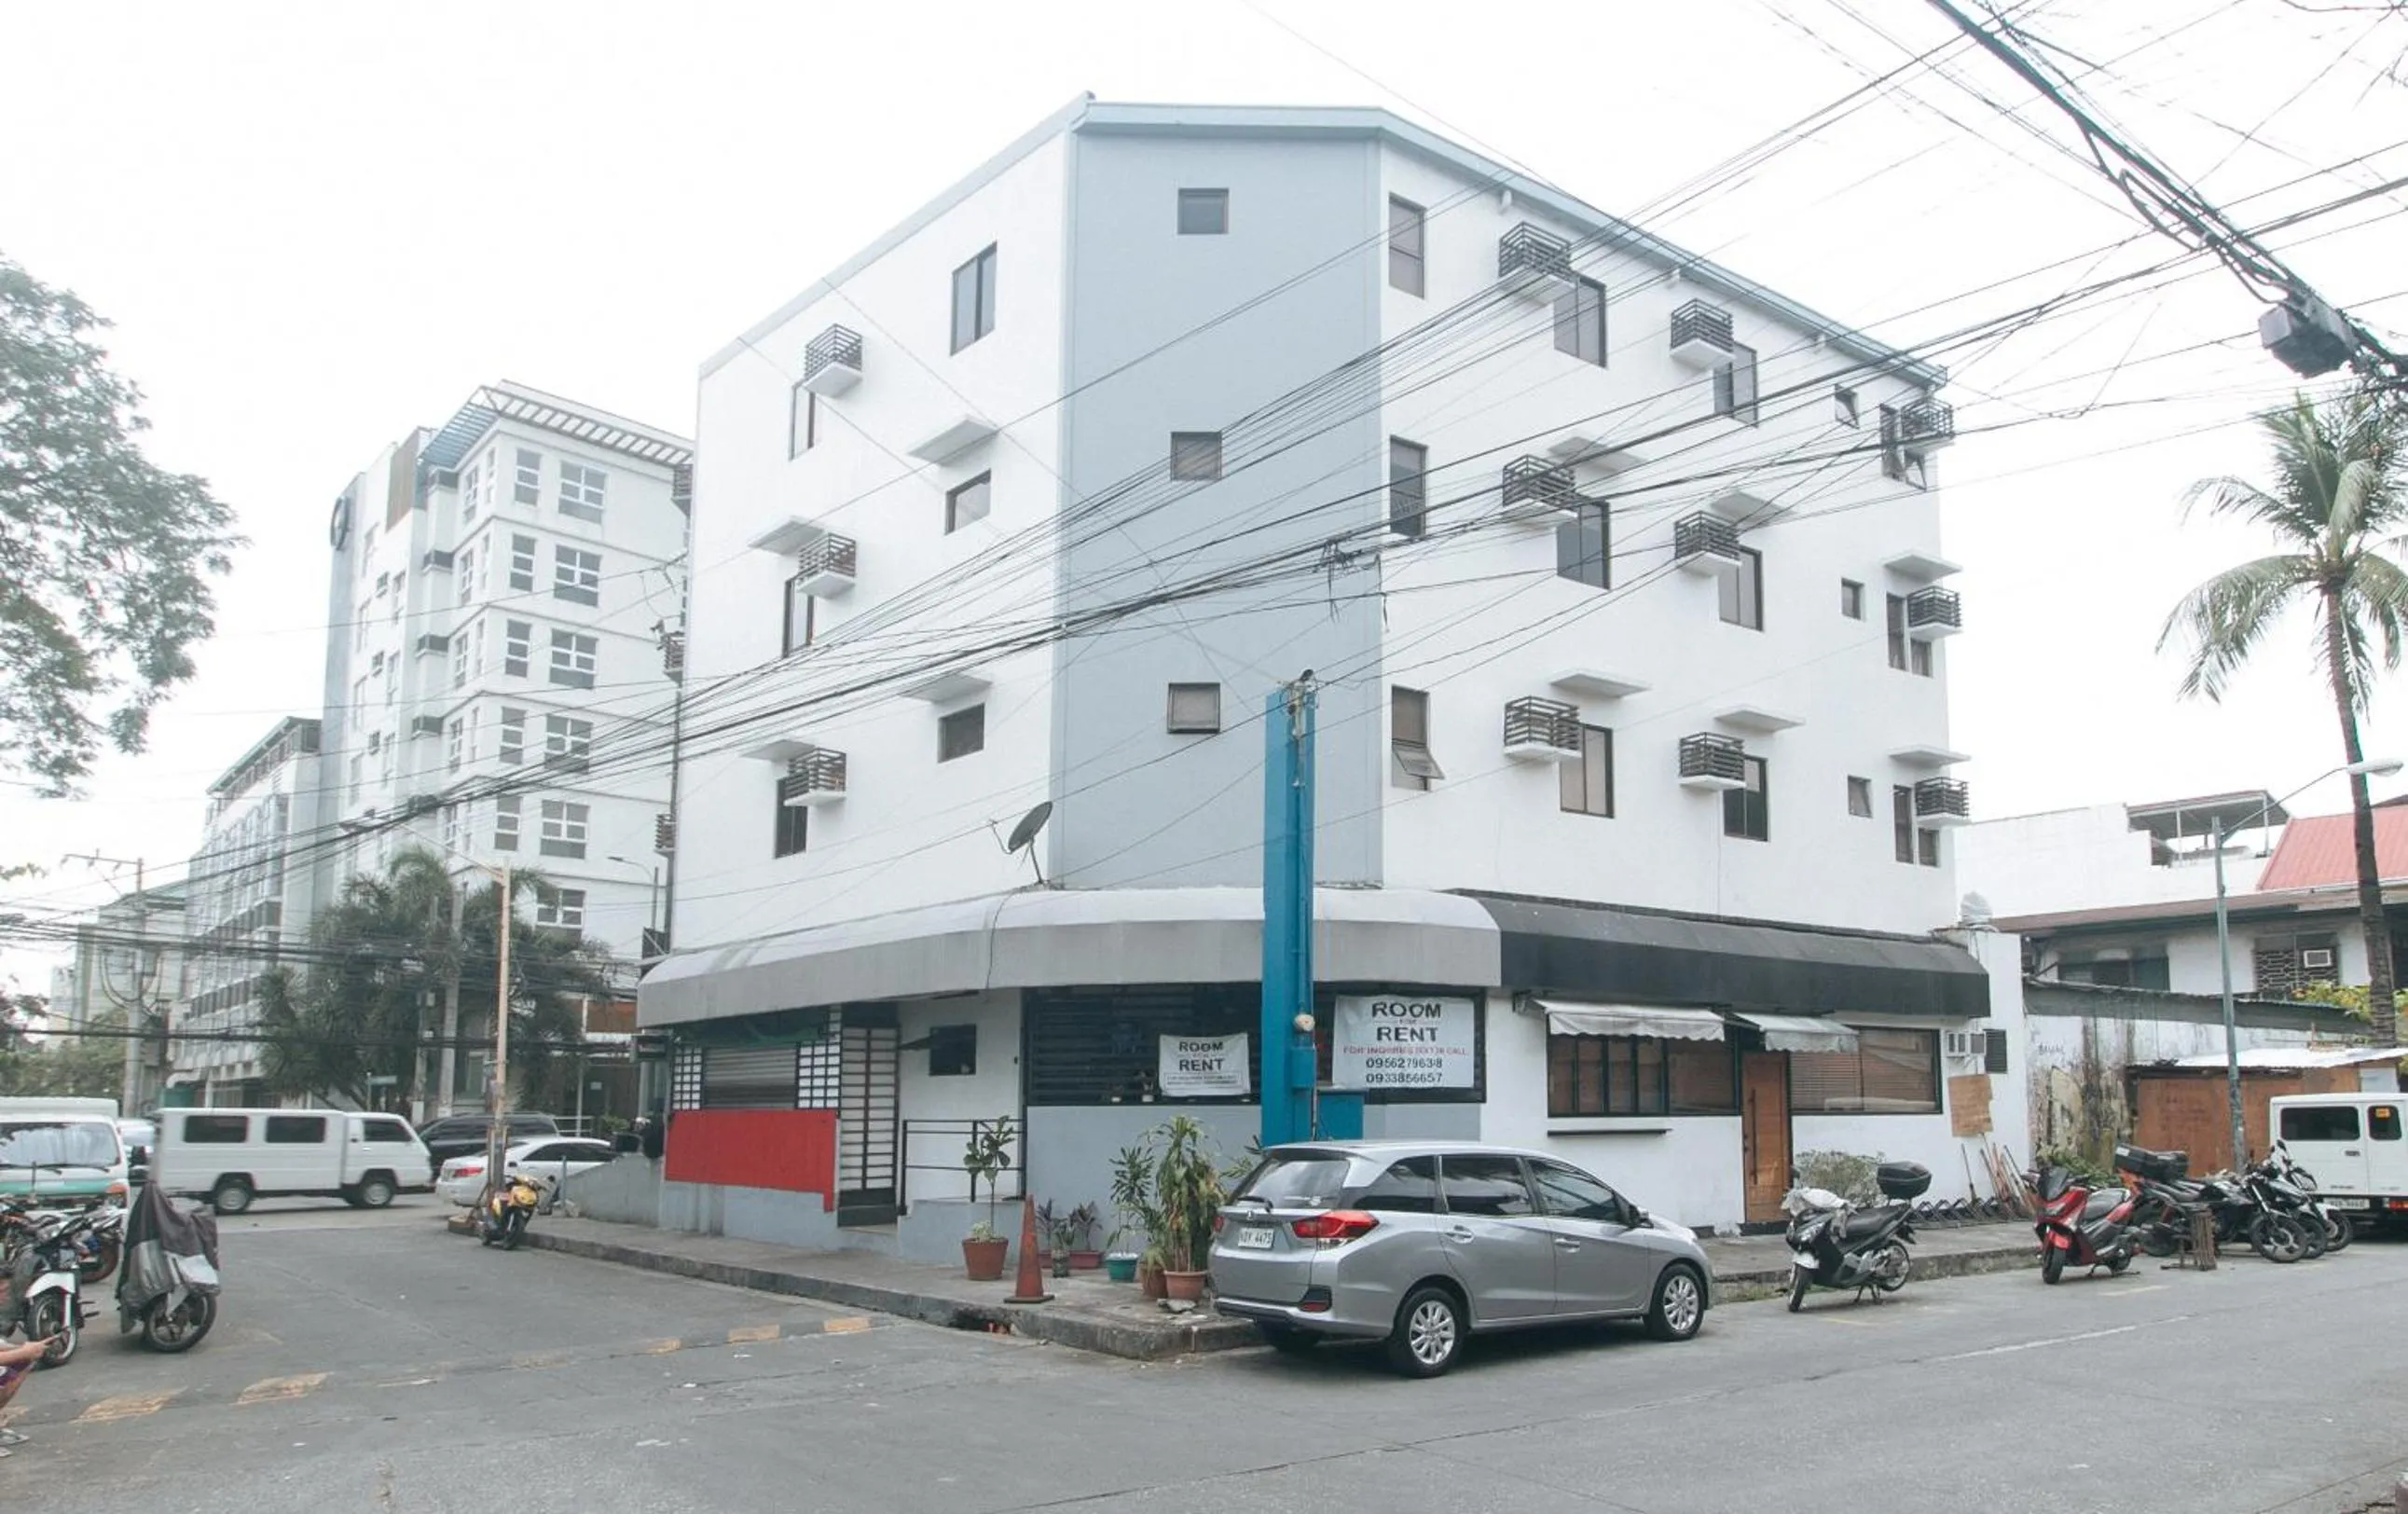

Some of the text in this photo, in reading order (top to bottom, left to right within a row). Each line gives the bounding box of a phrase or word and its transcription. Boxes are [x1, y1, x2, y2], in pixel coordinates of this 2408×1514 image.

[1371, 1002, 1441, 1018] ROOM
[1377, 1027, 1438, 1041] RENT
[1178, 1041, 1223, 1052] ROOM
[1179, 1058, 1225, 1071] RENT
